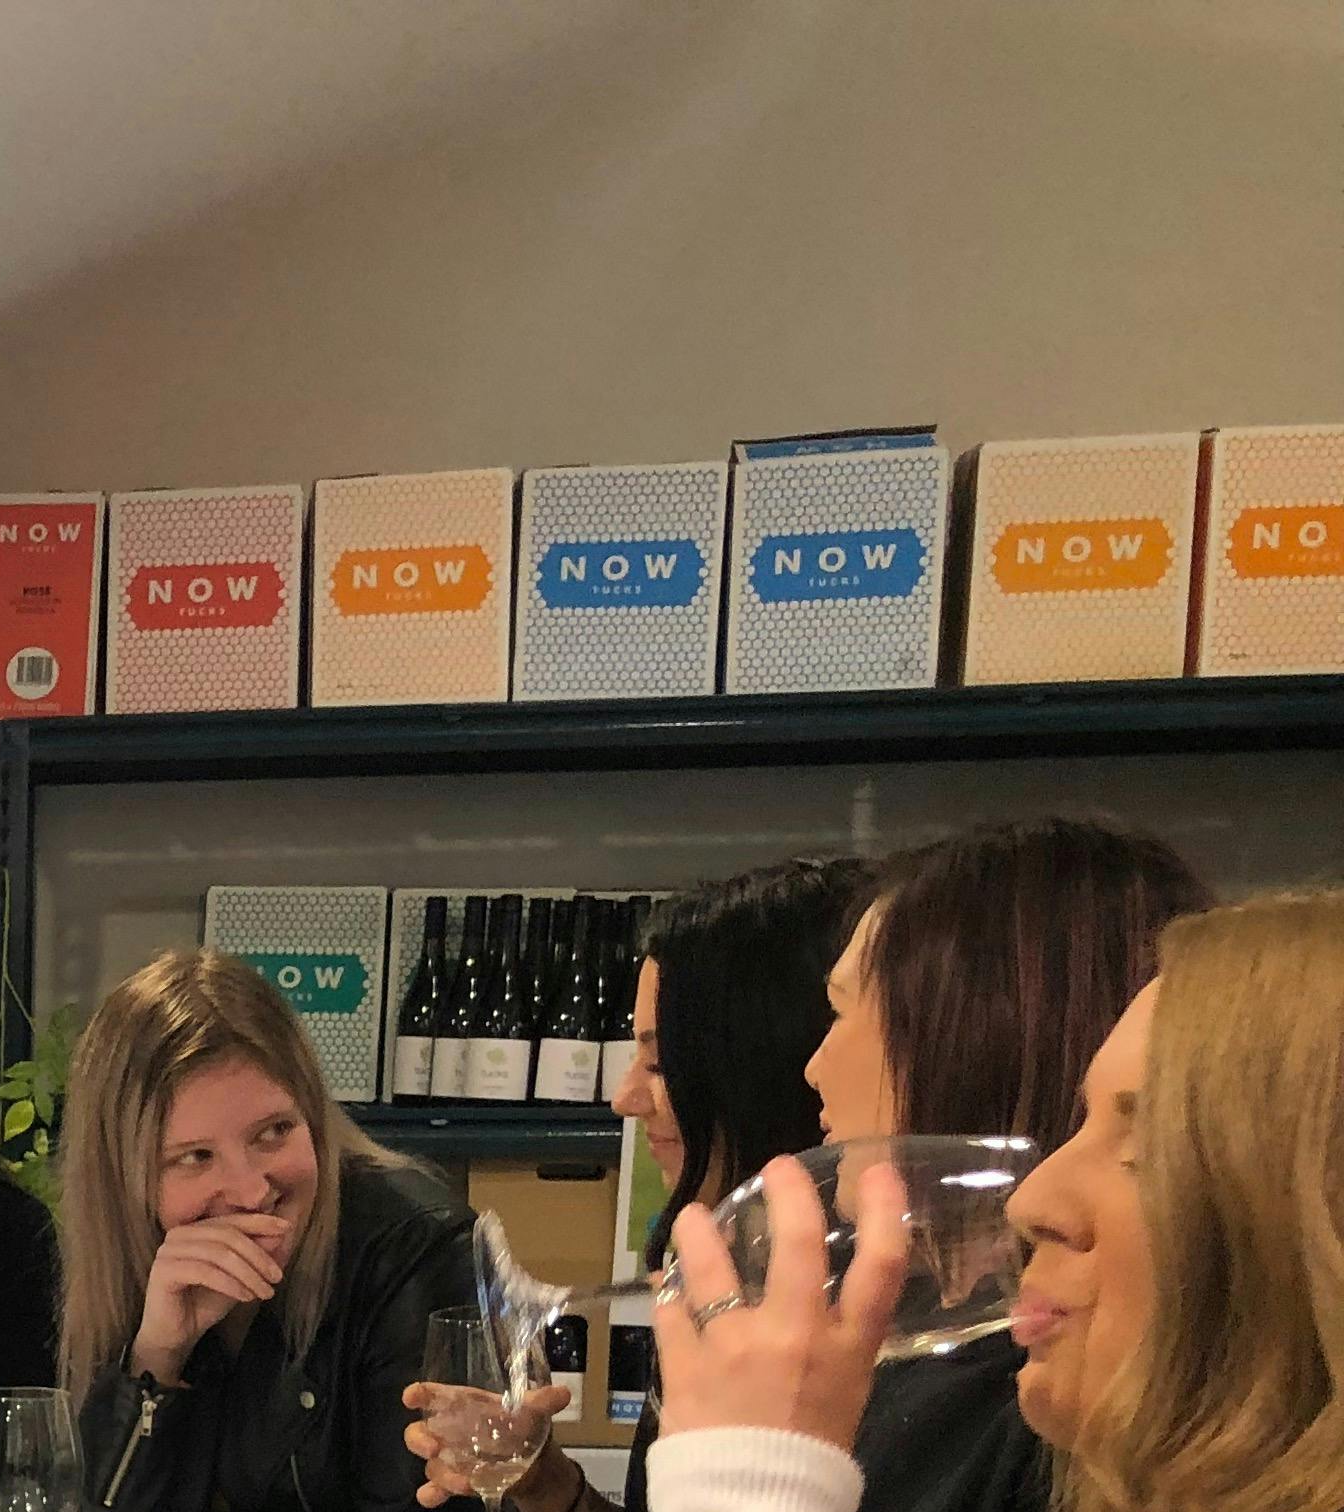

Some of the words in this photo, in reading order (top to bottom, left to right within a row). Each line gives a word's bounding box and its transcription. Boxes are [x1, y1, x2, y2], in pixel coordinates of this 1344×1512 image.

[0, 523, 81, 542] NOW
[1253, 521, 1328, 549] NO
[775, 543, 897, 575] NOW
[1017, 534, 1144, 564] NOW
[352, 560, 466, 590] NOW
[560, 554, 678, 582] NOW
[148, 575, 259, 605] NOW
